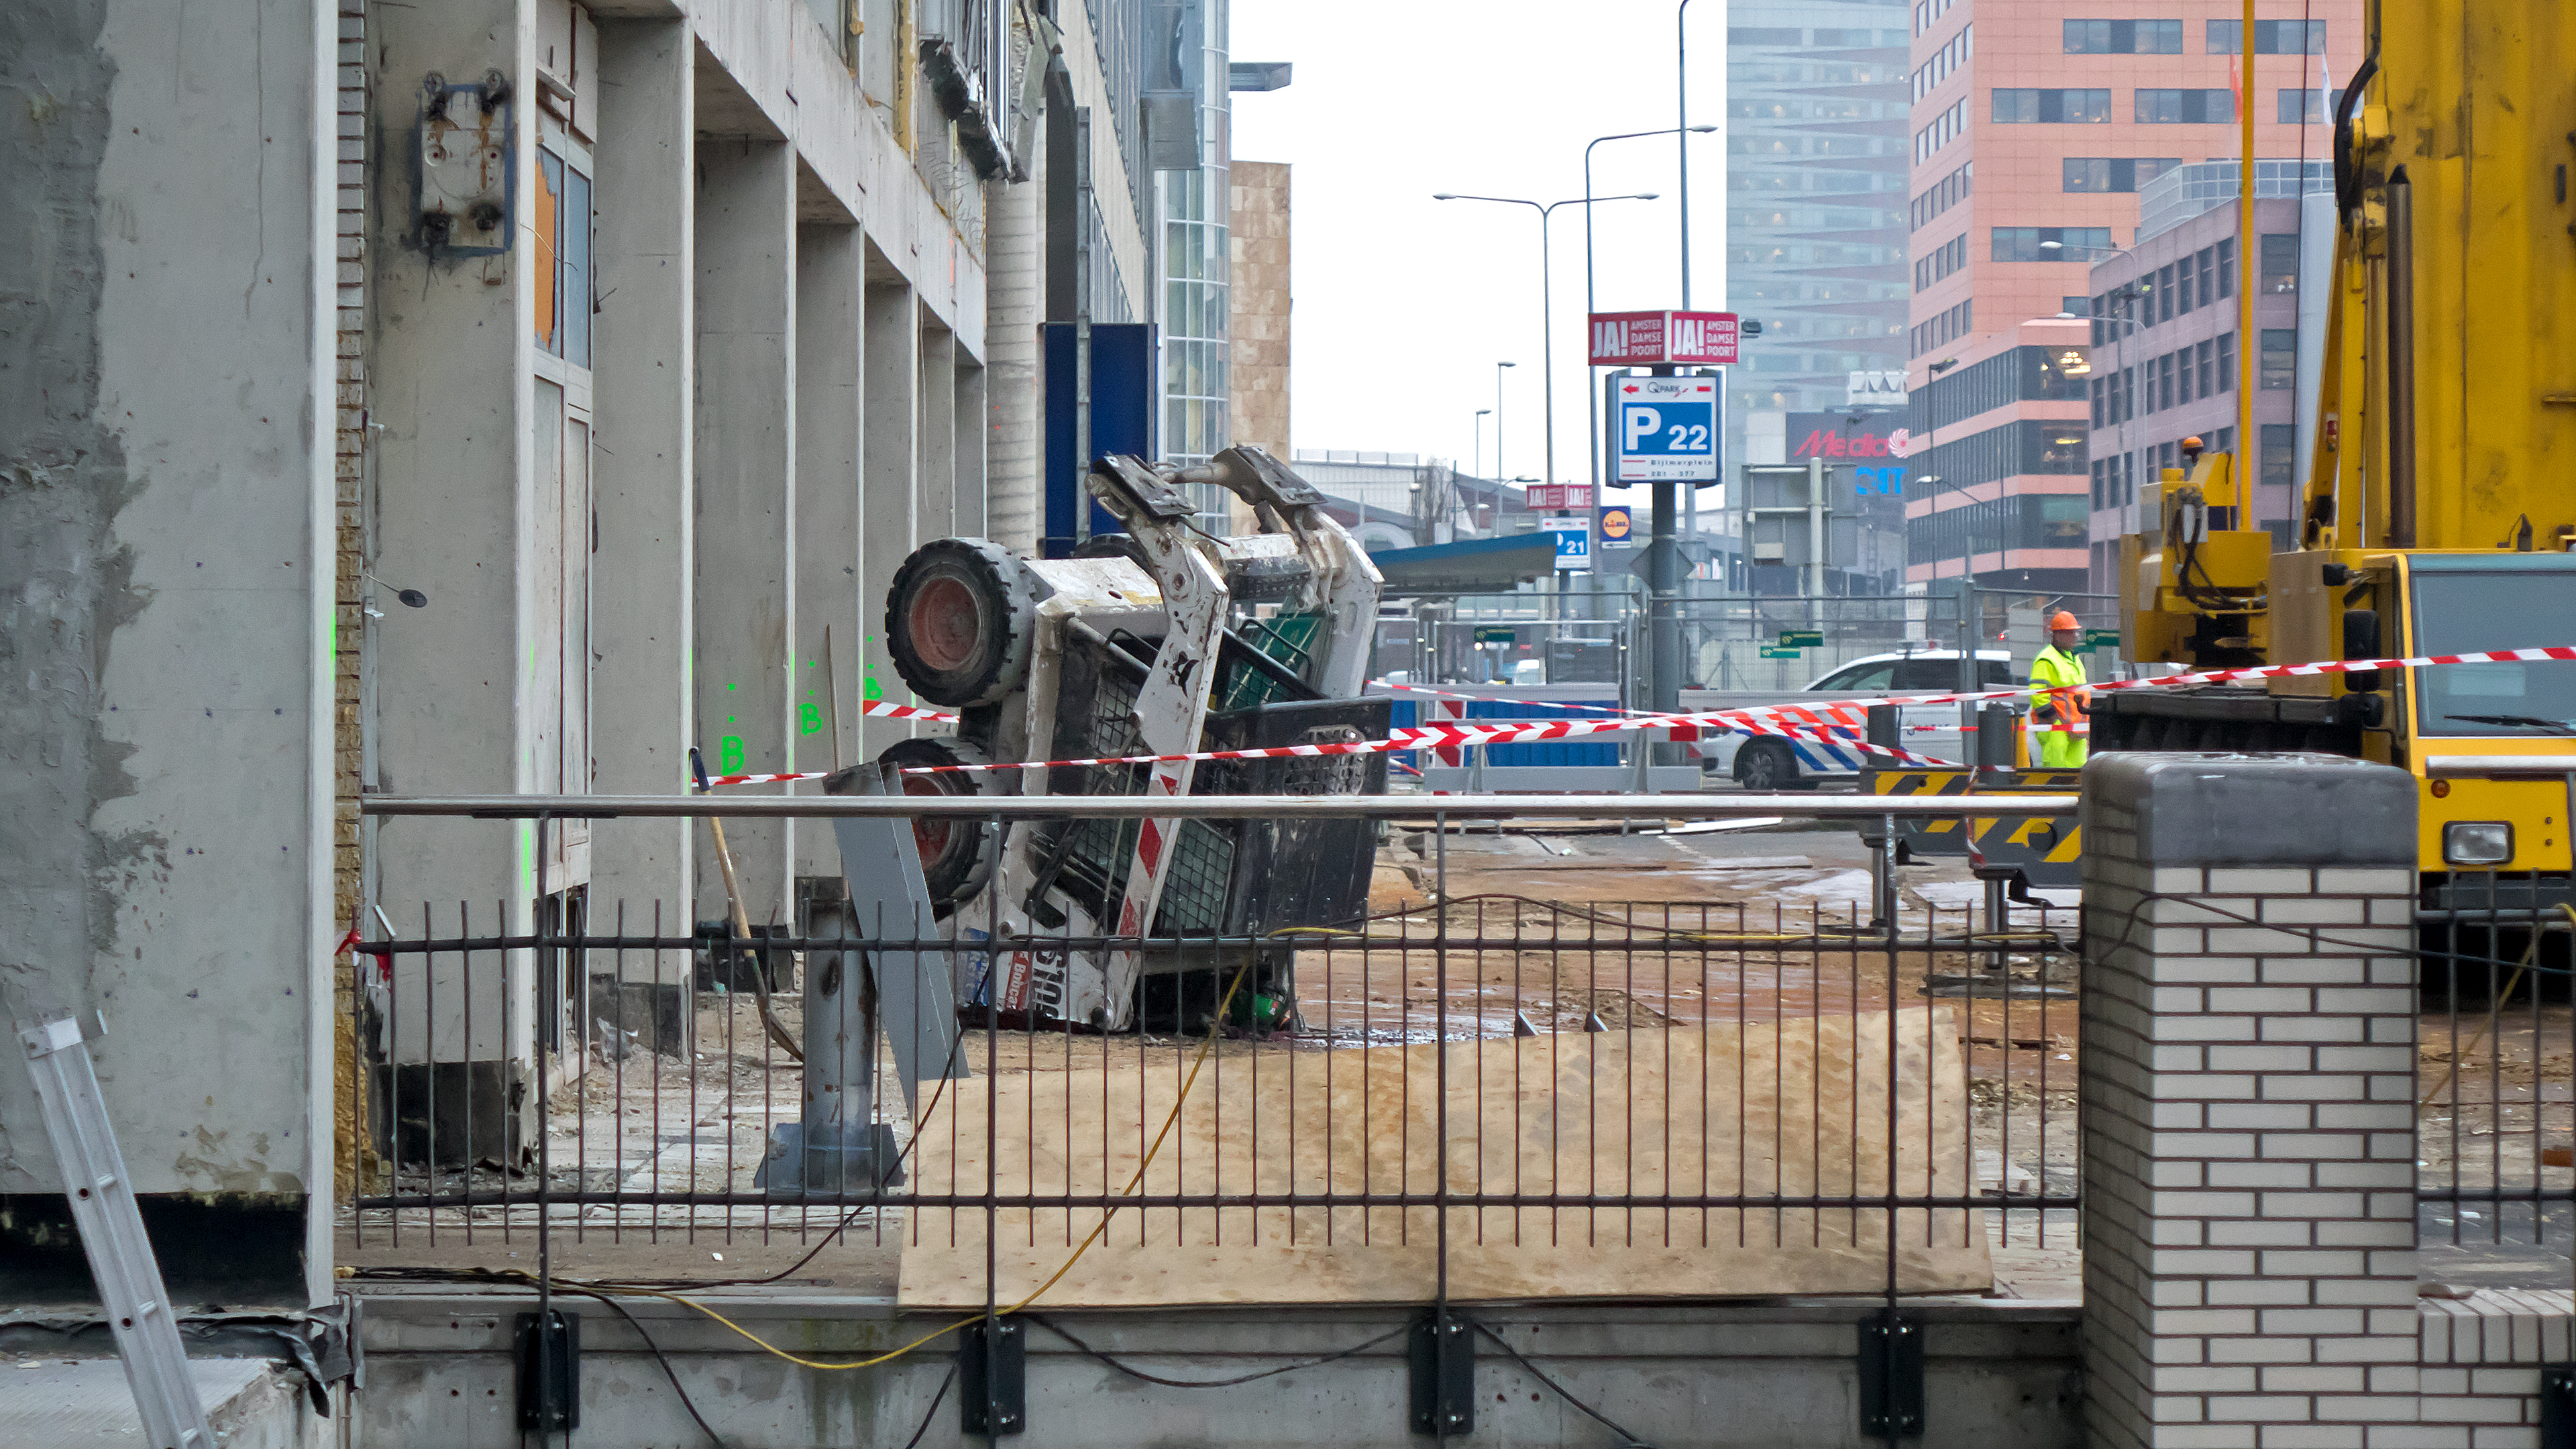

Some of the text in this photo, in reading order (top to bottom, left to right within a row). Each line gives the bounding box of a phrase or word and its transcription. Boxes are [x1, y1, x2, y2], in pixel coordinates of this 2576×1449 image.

[1630, 319, 1662, 331] AMSTER
[1707, 320, 1735, 331] AMSTER
[1592, 321, 1628, 358] JA!
[1630, 331, 1662, 343] DAMSE
[1672, 319, 1705, 356] JA!
[1707, 333, 1735, 343] DAMSE
[1630, 344, 1662, 356] POORT
[1707, 345, 1735, 357] POORT
[1625, 407, 1709, 451] P 22
[1794, 429, 1888, 458] Media
[1566, 540, 1585, 553] 21
[798, 702, 822, 736] B
[721, 735, 745, 775] B
[1007, 963, 1026, 1008] Bobca
